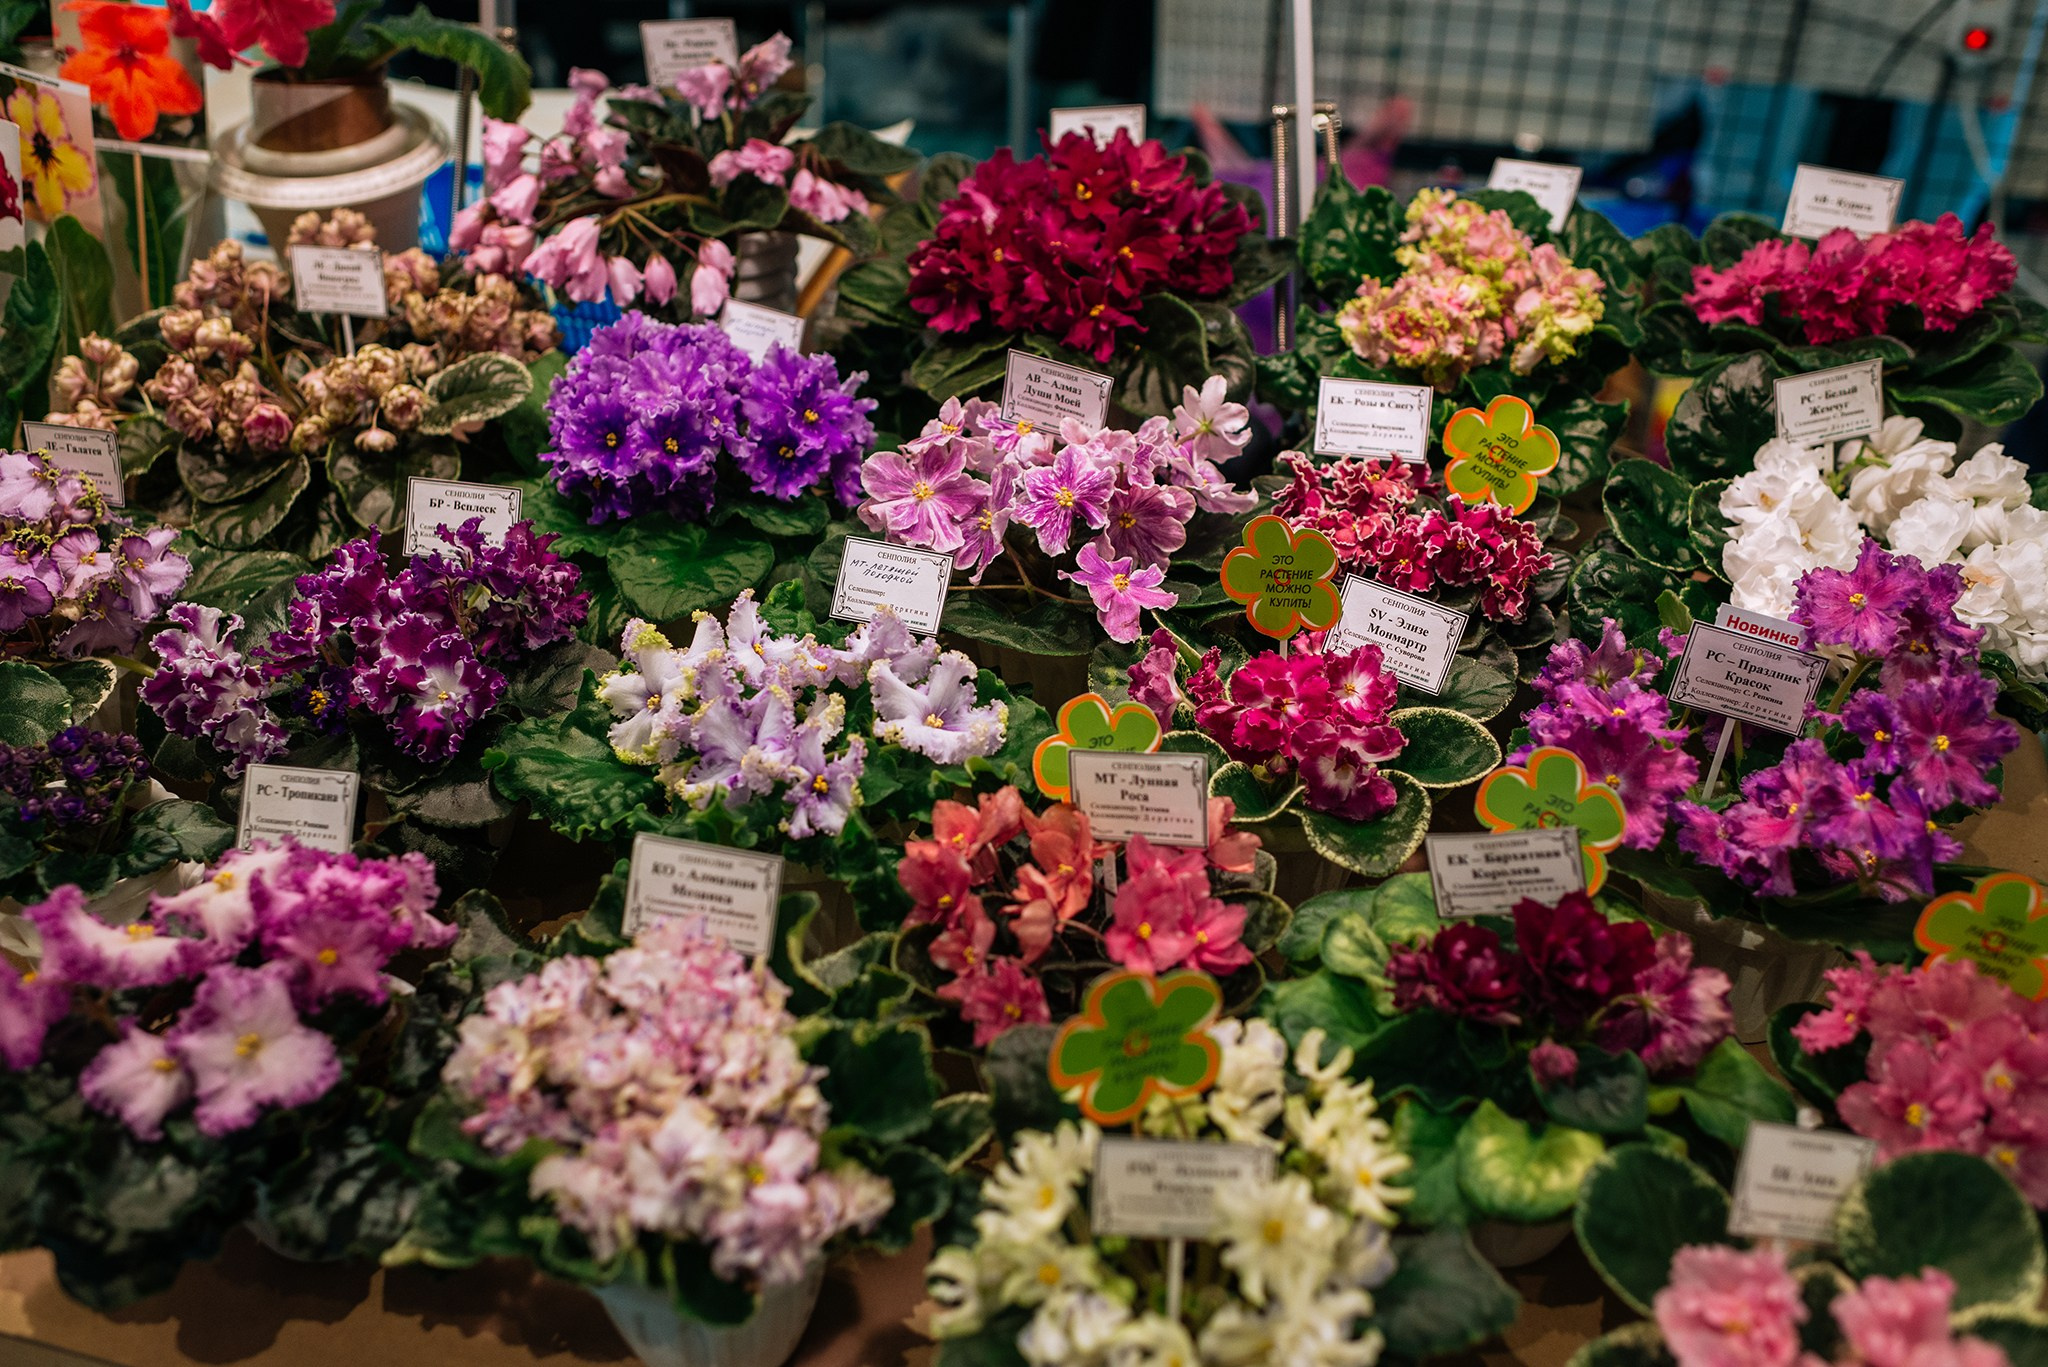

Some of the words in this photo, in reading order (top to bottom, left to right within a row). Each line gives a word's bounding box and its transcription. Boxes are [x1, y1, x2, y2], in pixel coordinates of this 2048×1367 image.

[1041, 367, 1079, 382] СЕНПОЛИЯ
[1026, 373, 1041, 383] АВ
[1051, 380, 1082, 395] Алмаз
[1024, 384, 1052, 399] Души
[1054, 394, 1081, 408] Моей
[1801, 394, 1814, 404] РС
[1825, 385, 1857, 399] Белый
[1330, 396, 1344, 404] ЕК
[1354, 398, 1377, 407] Розы
[1388, 400, 1414, 411] Снегу
[1810, 402, 1849, 415] Жемчуг
[54, 433, 87, 441] СЕНПОЛИЯ
[1497, 433, 1518, 448] ЭТО
[44, 441, 57, 451] ЛЕ
[66, 443, 102, 455] Галатея
[1479, 438, 1528, 469] РАСТЕНИЕ
[1475, 452, 1517, 478] МОЖНО
[1470, 464, 1510, 489] КУПИТЬ!
[445, 490, 485, 500] СЕНПОЛИЯ
[430, 498, 444, 508] БР
[454, 500, 496, 514] Всплеск
[877, 551, 917, 565] СЕНПОЛИЯ
[1272, 555, 1294, 565] ЭТО
[1260, 570, 1313, 579] РАСТЕНИЕ
[848, 584, 885, 597] Селекционер:
[1266, 584, 1311, 594] МОЖНО
[1269, 598, 1311, 608] КУПИТЬ!
[1382, 597, 1425, 617] СЕНПОЛИЯ
[1369, 607, 1387, 620] SV
[1395, 617, 1429, 636] Элизе
[1367, 623, 1427, 653] Монмартр
[1726, 615, 1800, 646] Новинка
[1344, 628, 1384, 647] Селекционер:
[1394, 647, 1425, 662] Суворова
[1732, 642, 1782, 661] СЕНПОЛИЯ
[1386, 656, 1431, 676] Дерягина
[1706, 650, 1725, 663] РС
[1738, 659, 1801, 685] Праздник
[1725, 671, 1772, 691] Красок
[1695, 676, 1741, 694] Селекционер:
[1753, 692, 1783, 705] Репкина
[1691, 687, 1741, 706] Коллекционер:
[1743, 702, 1792, 720] Дерягина
[1089, 734, 1114, 749] ЭТО
[281, 775, 320, 784] СЕНПОЛИЯ
[1095, 773, 1117, 784] МТ
[1129, 775, 1178, 788] Лунная
[257, 784, 272, 796] РС
[282, 787, 338, 802] Тропикана
[1120, 789, 1149, 801] Роса
[1546, 794, 1574, 813] ЭТО
[1484, 849, 1561, 864] Бархатная
